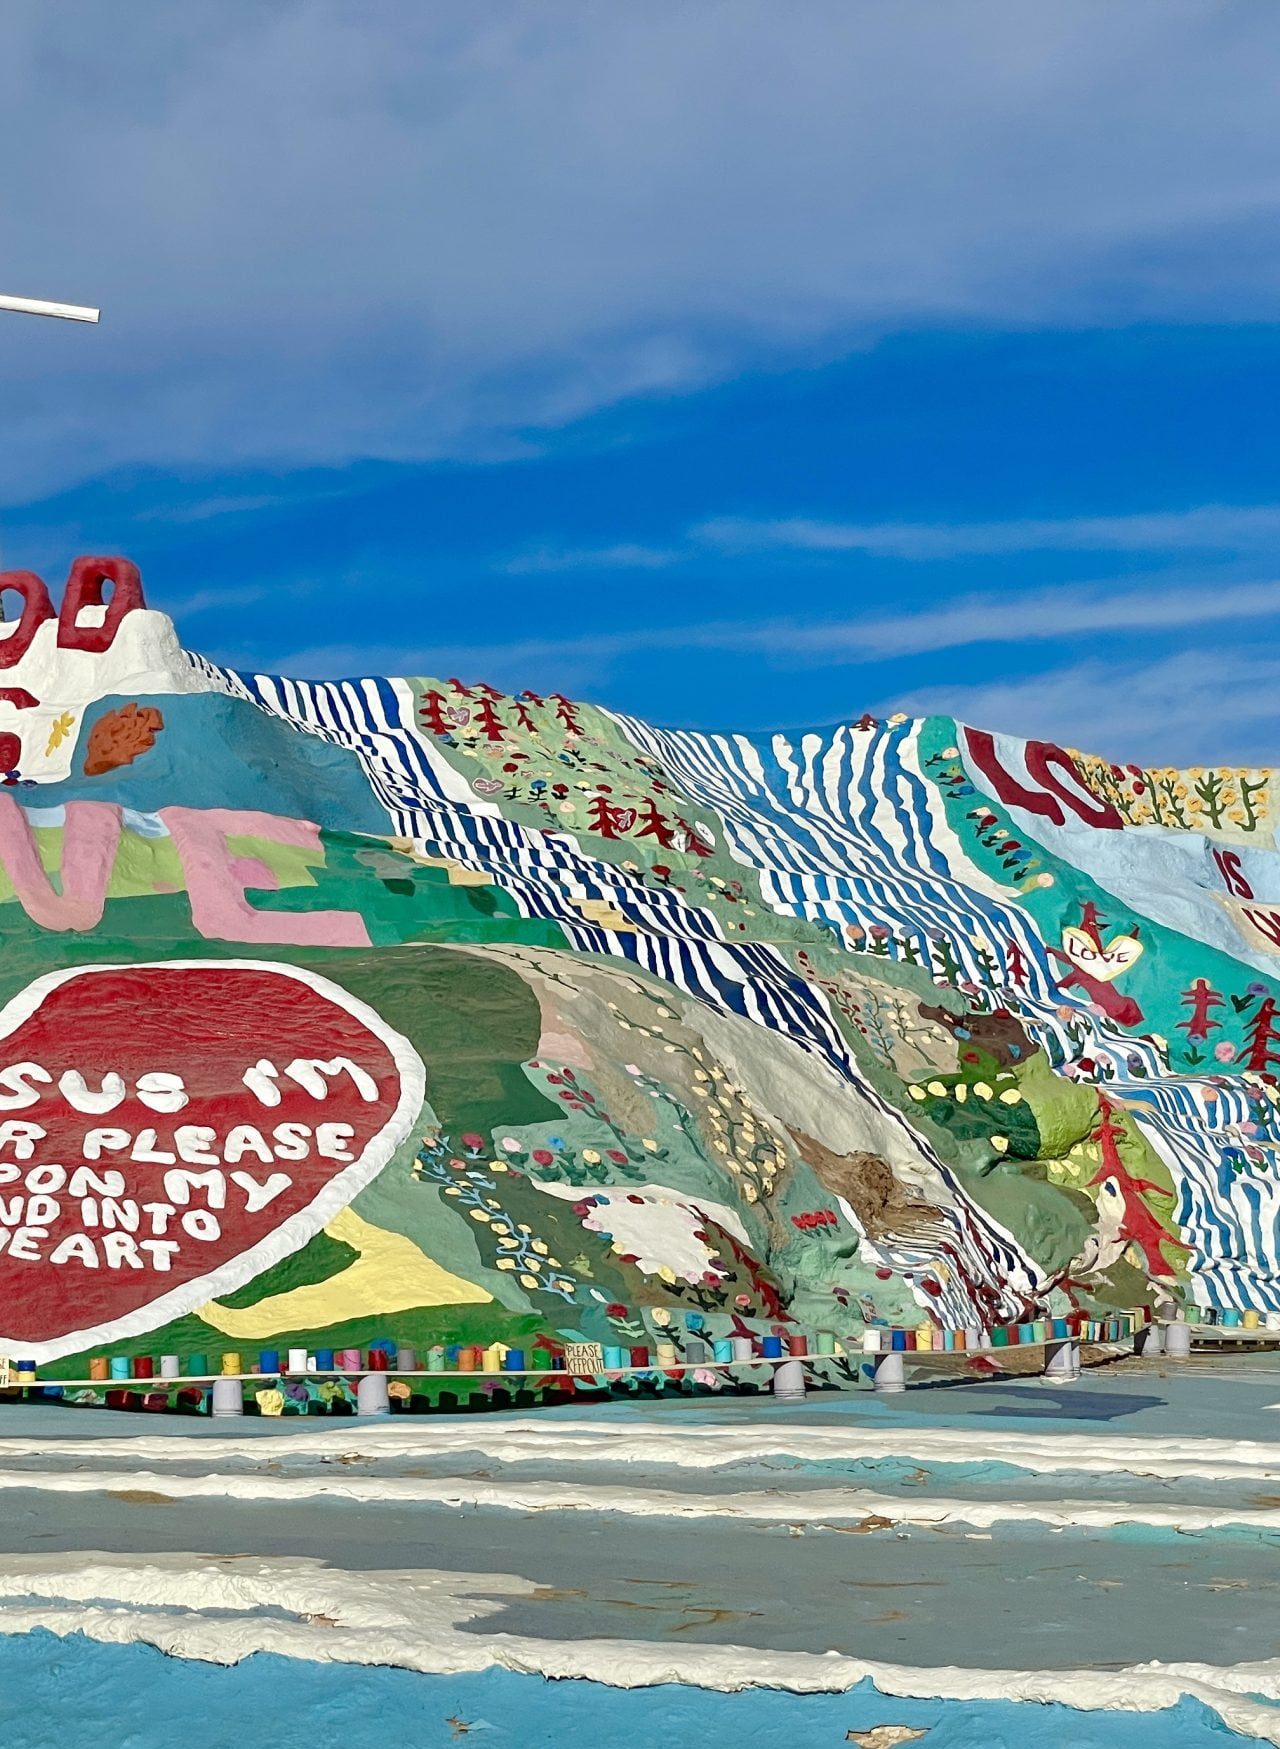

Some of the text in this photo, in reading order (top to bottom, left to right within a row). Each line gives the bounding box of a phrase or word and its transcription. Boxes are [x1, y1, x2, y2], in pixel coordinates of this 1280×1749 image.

[1213, 848, 1254, 899] IS
[1069, 938, 1130, 963] LOVE
[241, 1057, 379, 1107] I'M
[82, 1121, 355, 1165] PLEASE
[163, 1168, 292, 1213] MY
[80, 1196, 221, 1241] INTO
[567, 1345, 599, 1358] PLEASE
